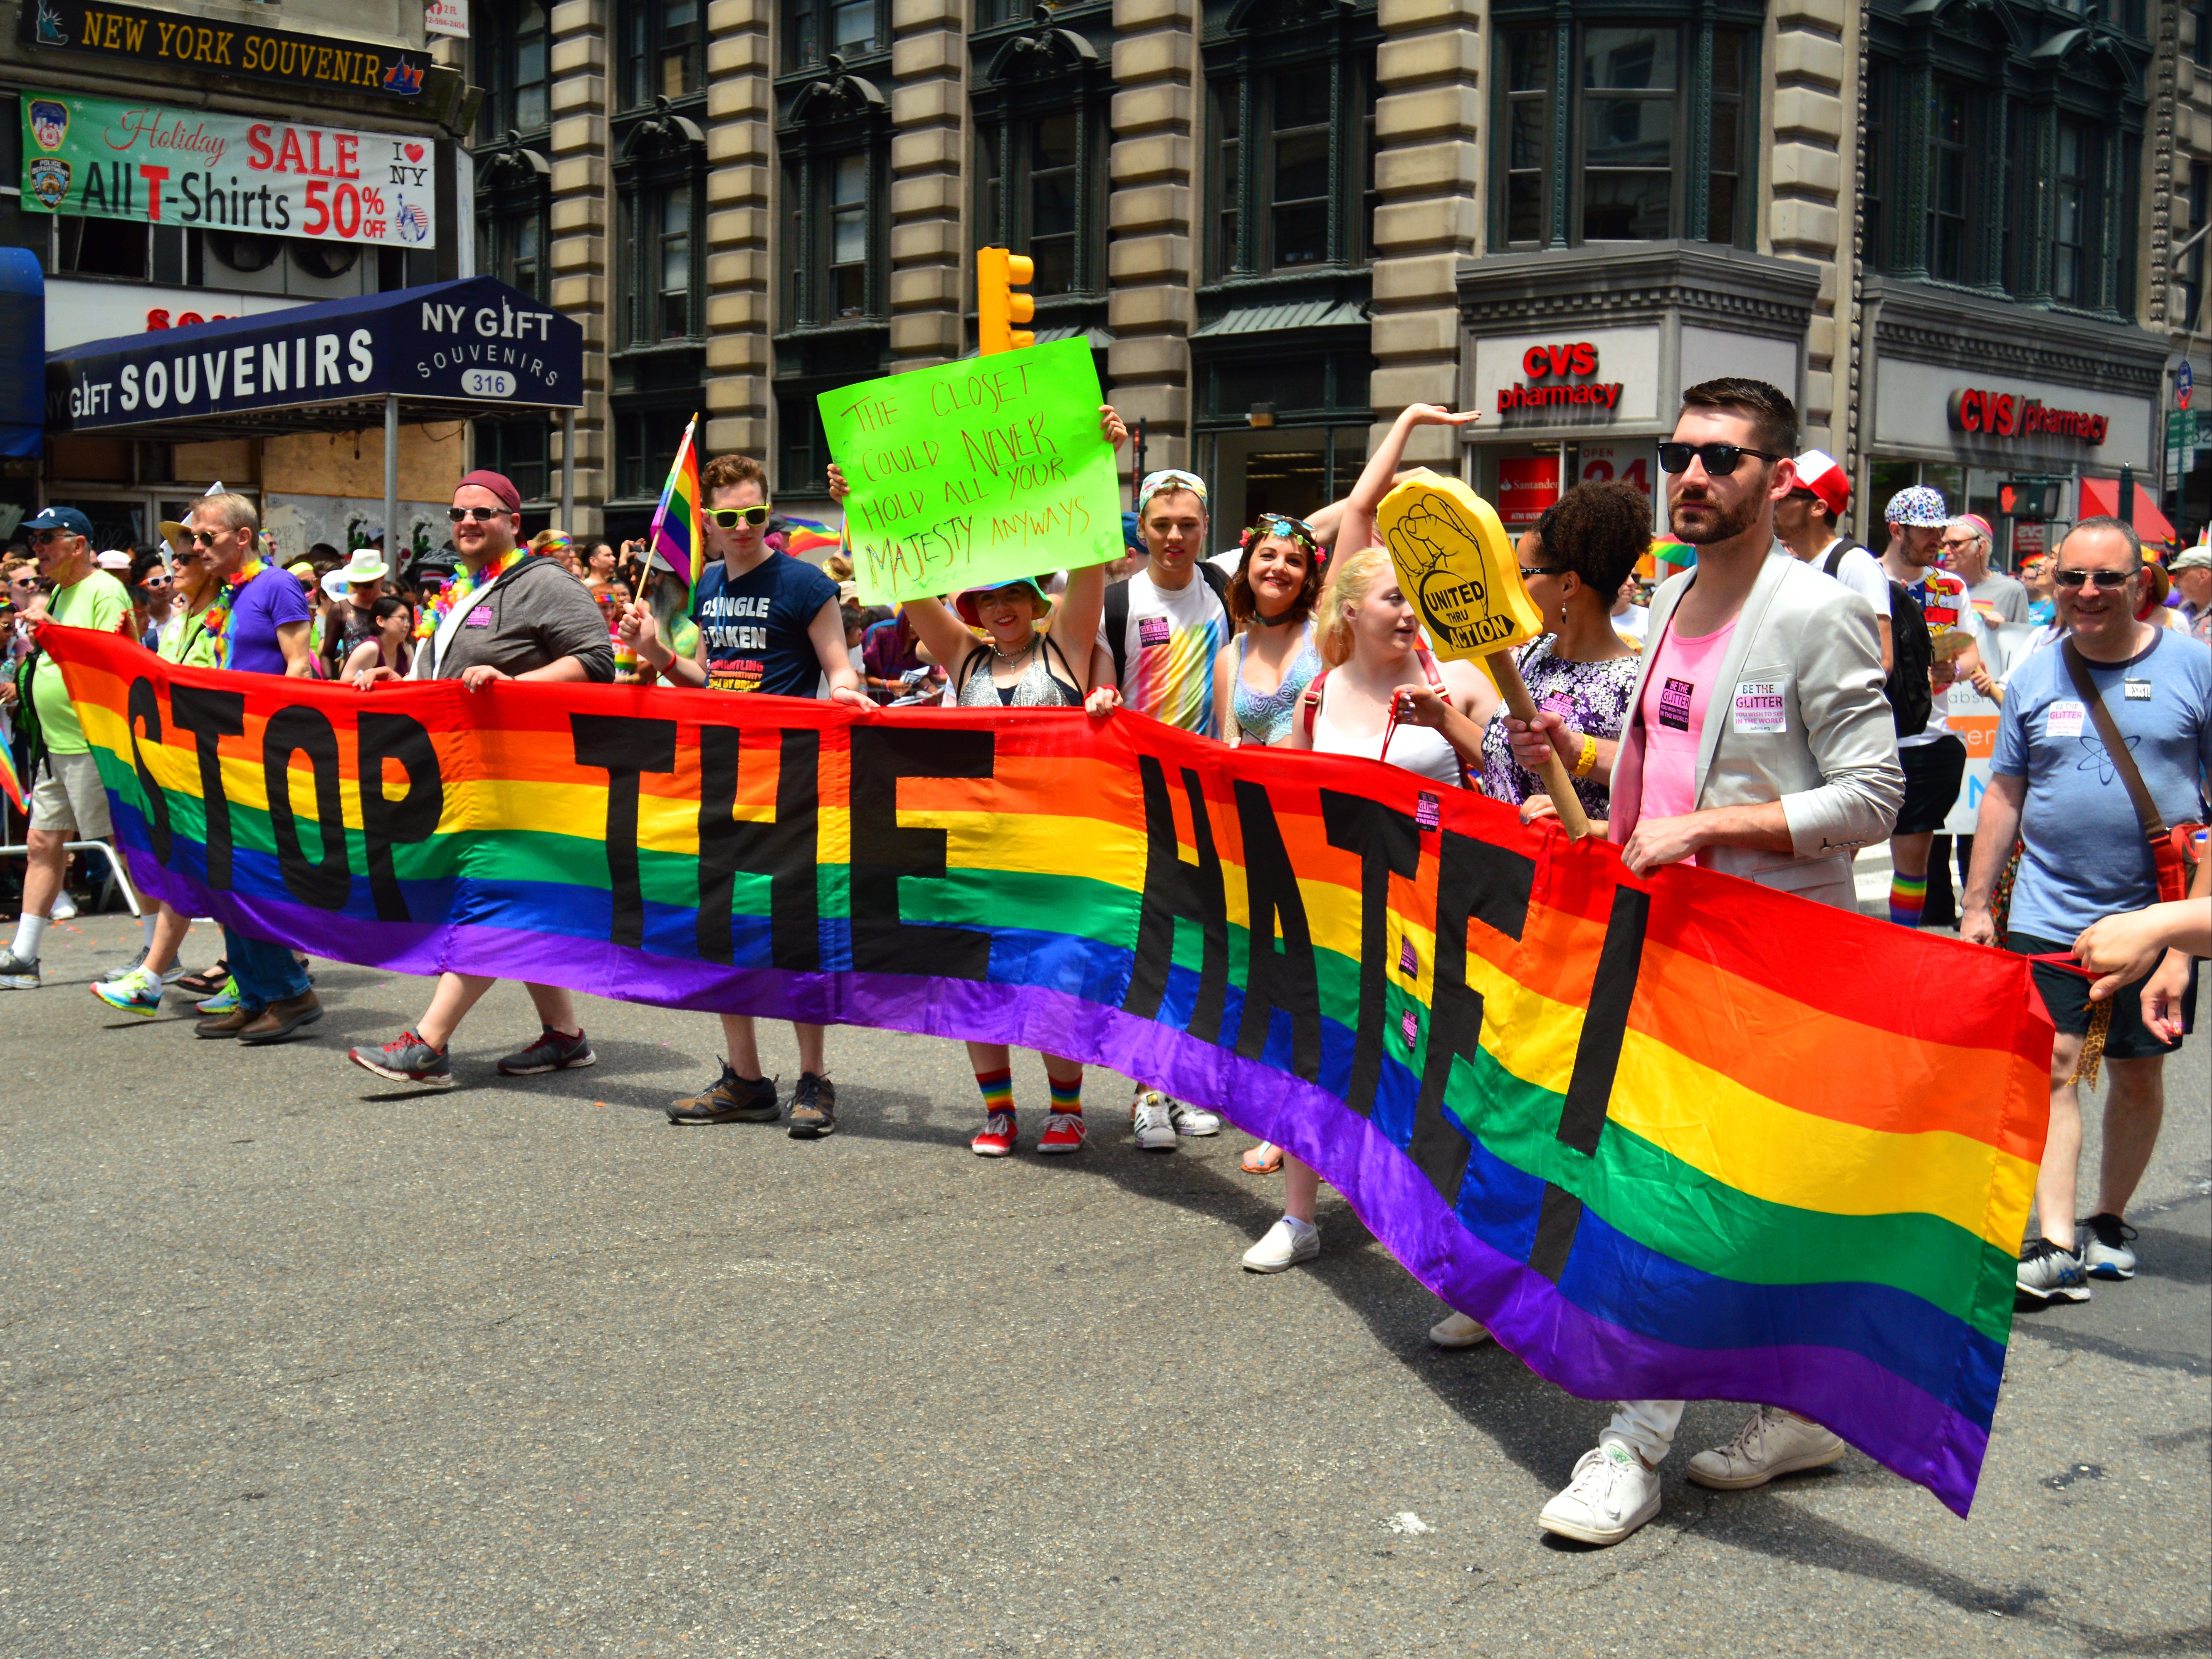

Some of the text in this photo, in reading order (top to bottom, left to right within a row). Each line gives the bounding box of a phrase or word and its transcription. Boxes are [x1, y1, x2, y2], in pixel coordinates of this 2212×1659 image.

[82, 11, 381, 86] NEW YORK SOUVENIR
[104, 109, 227, 167] Holiday
[247, 124, 360, 180] SALE
[390, 165, 427, 186] NY
[80, 161, 131, 215] All
[139, 165, 290, 230] T-Shirts
[363, 219, 386, 238] OFF
[422, 295, 553, 341] NY GIFT
[69, 372, 112, 417] GIFT
[120, 329, 373, 411] SOUVENIRS
[417, 344, 558, 386] SOUVENIRS
[1523, 342, 1598, 378] CVS
[473, 375, 505, 393] 316
[841, 362, 1033, 431] THE CLOSET
[1498, 383, 1619, 413] pharmacy
[1960, 388, 2109, 445] CVS/pharmacy
[863, 411, 1057, 481] COULD NEVER
[1583, 448, 1614, 457] OPEN
[861, 457, 1067, 531] HOLD ALL YOUR
[1513, 478, 1559, 490] Santander
[865, 495, 1090, 595] MAJESTY ANYWAYS
[710, 597, 770, 618] SINGLE
[1425, 580, 1484, 612] UNITED
[1141, 624, 1168, 633] GLITTER
[1446, 609, 1469, 623] THRU
[708, 626, 766, 649] TAKEN
[1449, 615, 1509, 651] ACTION
[1553, 692, 1574, 705] BE THE
[1663, 690, 1689, 709] GLITTER
[1670, 680, 1689, 694] BE THE
[1743, 684, 1774, 694] BE THE
[2125, 683, 2151, 698] RESIST!
[1545, 699, 1572, 715] GLITTER
[1735, 696, 1783, 708] GLITTER
[1673, 714, 1688, 723] WORLD
[128, 676, 444, 922] STOP
[569, 712, 995, 982] THE
